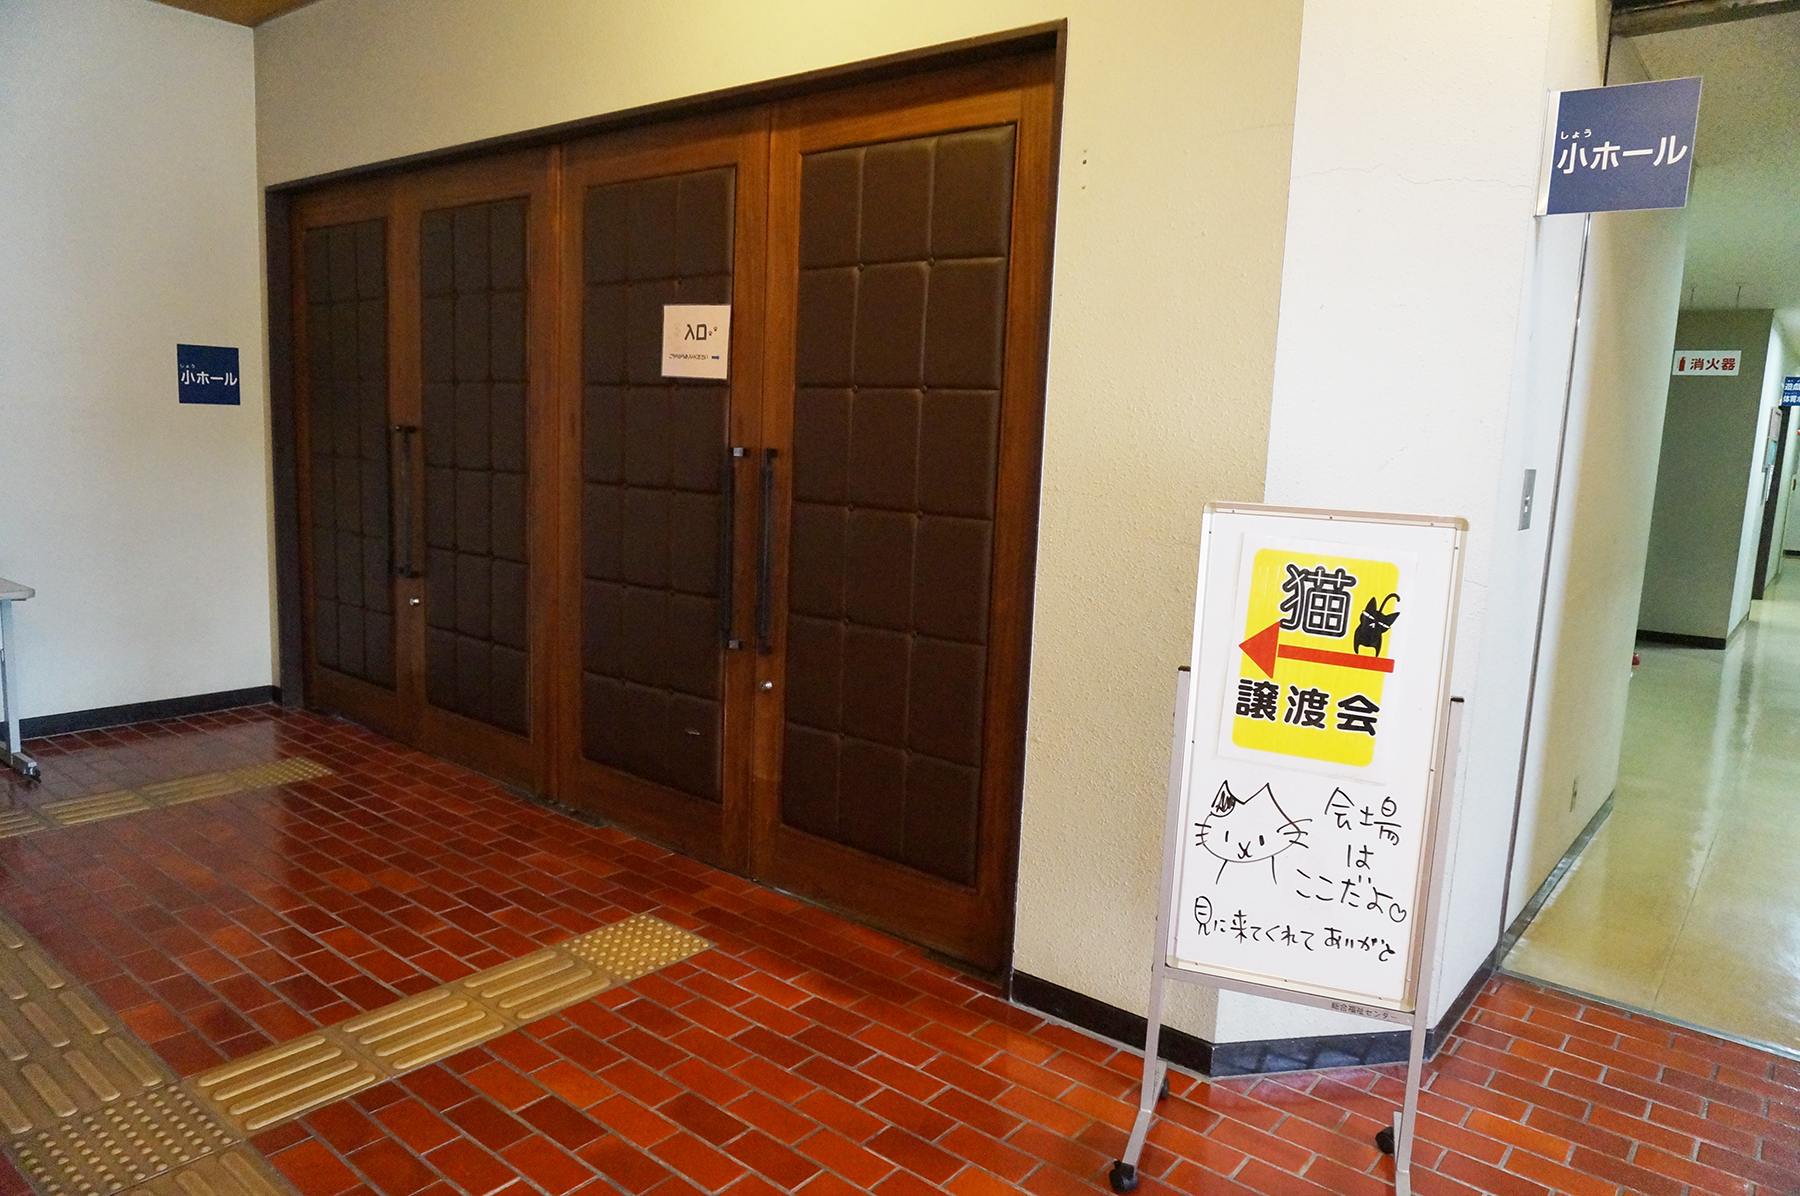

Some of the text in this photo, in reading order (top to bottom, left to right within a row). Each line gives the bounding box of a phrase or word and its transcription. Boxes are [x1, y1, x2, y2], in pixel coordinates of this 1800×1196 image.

[1560, 128, 1592, 140] しょう
[1556, 135, 1688, 174] 小ホール
[684, 323, 707, 340] 入口
[181, 369, 238, 386] 小ホール
[1690, 358, 1736, 371] 消火器
[1279, 563, 1357, 638] 猫
[1235, 678, 1380, 737] 譲渡会
[1324, 787, 1402, 846] 会場
[1346, 844, 1374, 870] は
[1296, 868, 1394, 914] ここだよ
[1194, 895, 1315, 951] 見に来てくれて
[1331, 1002, 1397, 1019] 総合福祉センター
